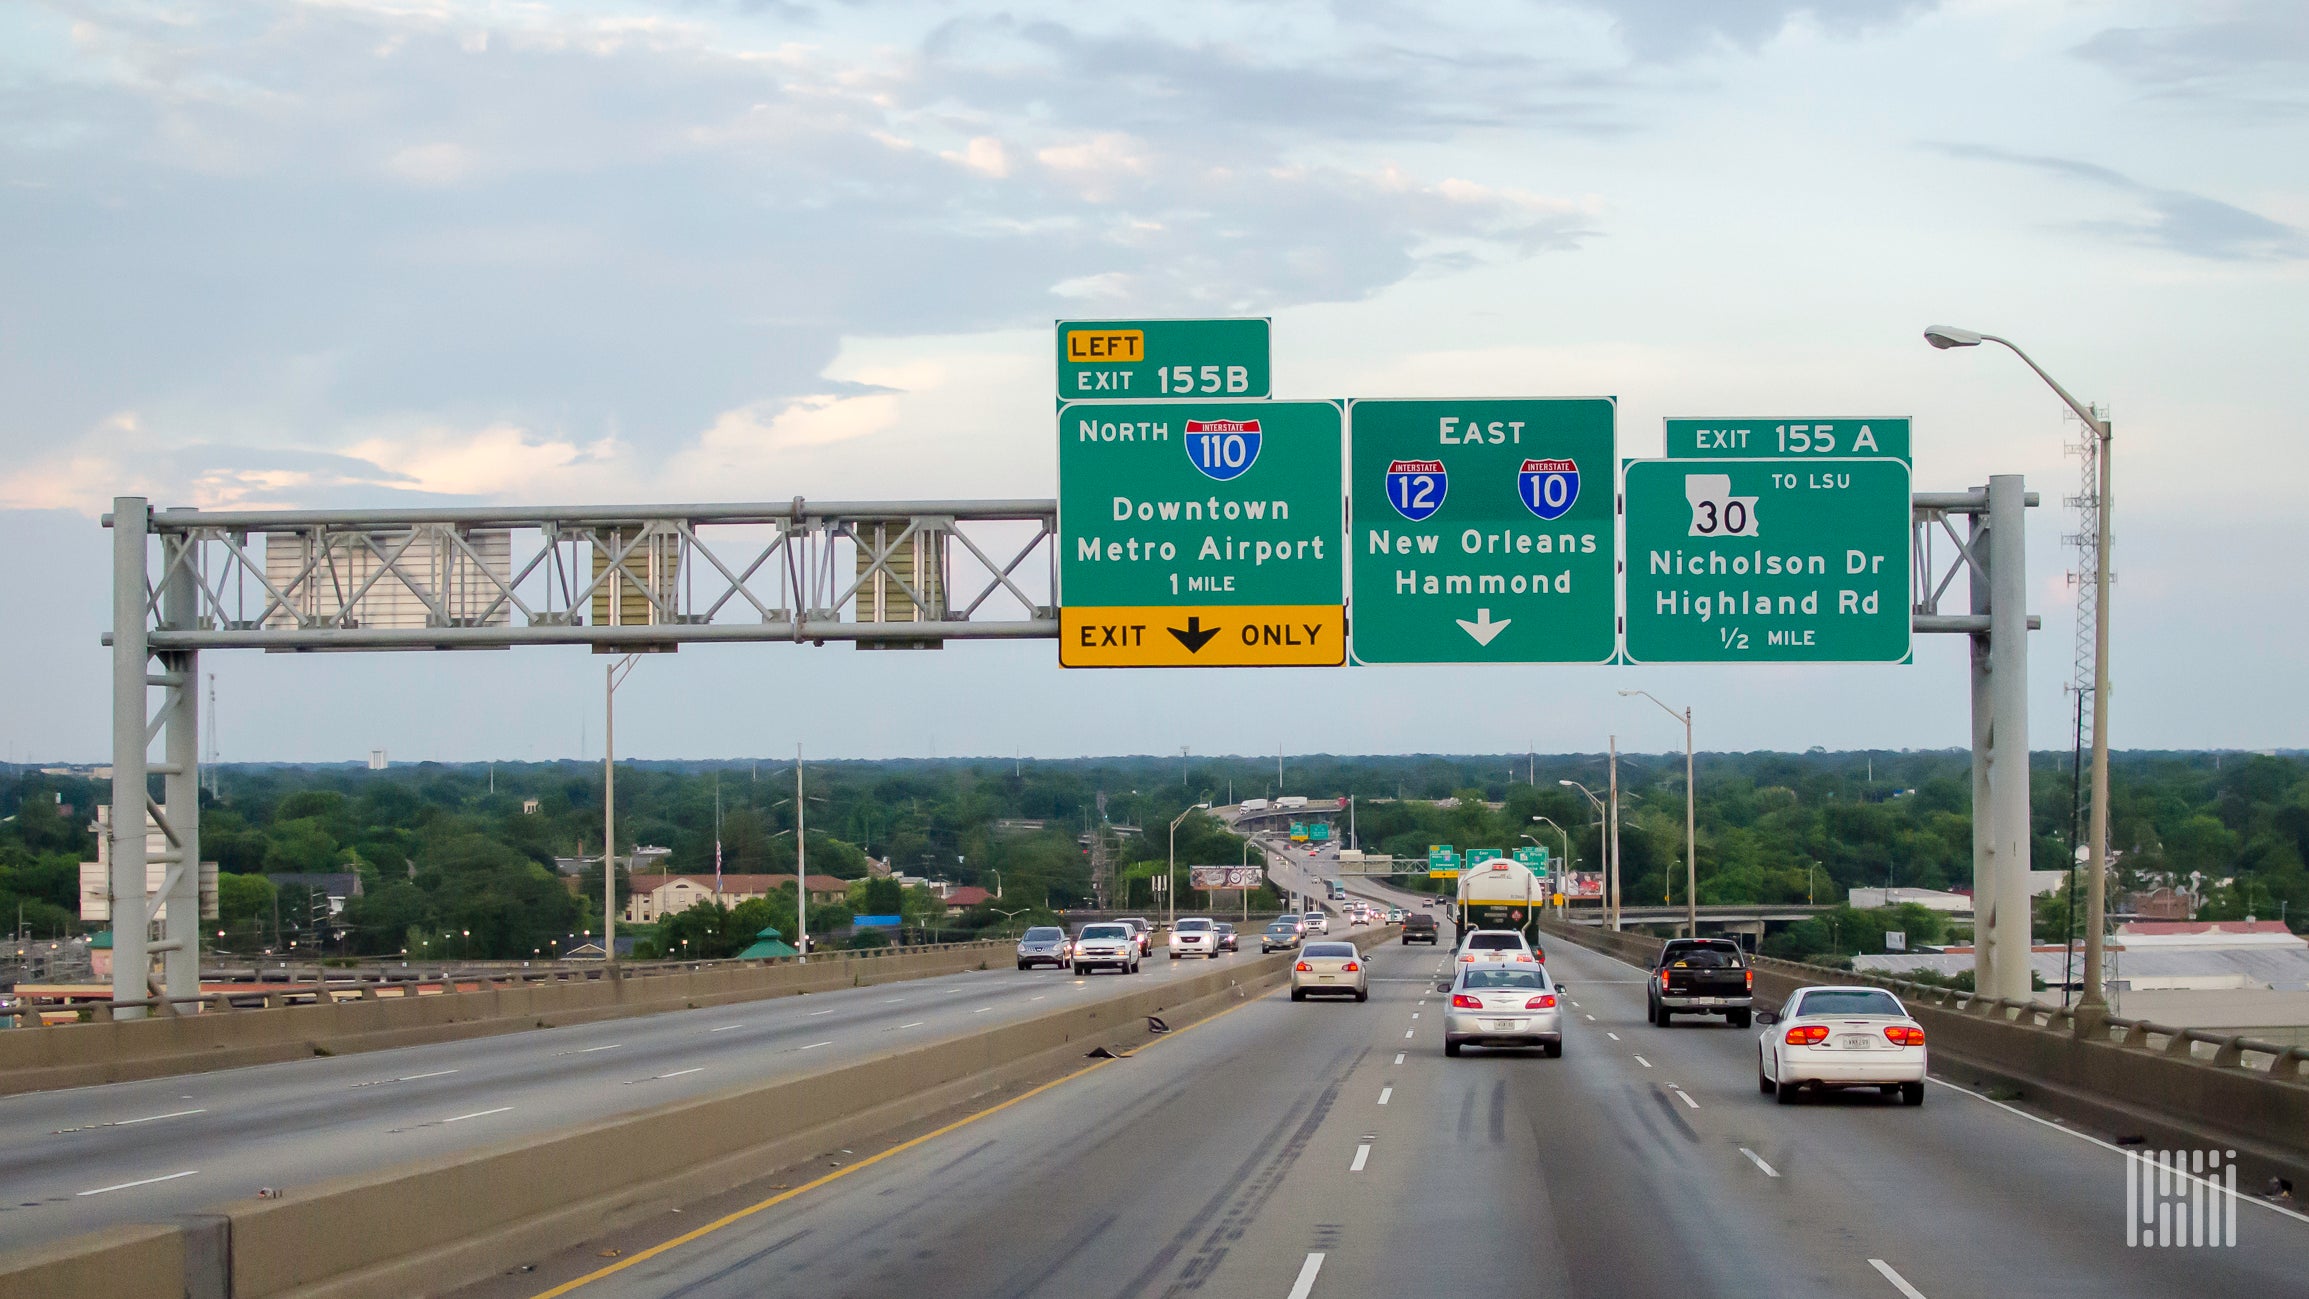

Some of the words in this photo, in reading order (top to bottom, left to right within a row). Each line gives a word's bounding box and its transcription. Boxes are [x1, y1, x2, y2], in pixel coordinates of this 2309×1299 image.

[1072, 336, 1138, 356] LEFT
[1078, 372, 1133, 390] EXIT
[1158, 366, 1248, 393] 155B
[1080, 420, 1167, 441] NORTH
[1202, 423, 1244, 432] INTERSTATE
[1440, 417, 1525, 444] EAST
[1697, 430, 1750, 448] EXIT
[1776, 425, 1835, 452] 155
[1852, 425, 1878, 452] A
[1200, 435, 1246, 468] 110
[1395, 464, 1437, 472] INTERSTATE
[1527, 462, 1570, 471] INTERSTATE
[1398, 476, 1435, 509] 12
[1530, 474, 1568, 508] 10
[1772, 474, 1797, 489] TO
[1810, 474, 1849, 488] LSU
[1114, 497, 1288, 520] Downtown
[1696, 501, 1746, 534] 30
[1078, 537, 1176, 561] Metro
[1199, 536, 1323, 565] Airport
[1370, 530, 1439, 554] New
[1462, 529, 1596, 553] Orleans
[1651, 550, 1824, 574] Nicholson
[1847, 550, 1884, 574] Dr
[1170, 573, 1178, 594] 1
[1189, 576, 1234, 591] MILE
[1396, 570, 1570, 594] Hammond
[1657, 591, 1817, 622] Highland
[1839, 590, 1878, 614] Rd
[1081, 625, 1146, 646] EXIT
[1242, 624, 1321, 646] ONLY
[1768, 630, 1815, 645] MILE
